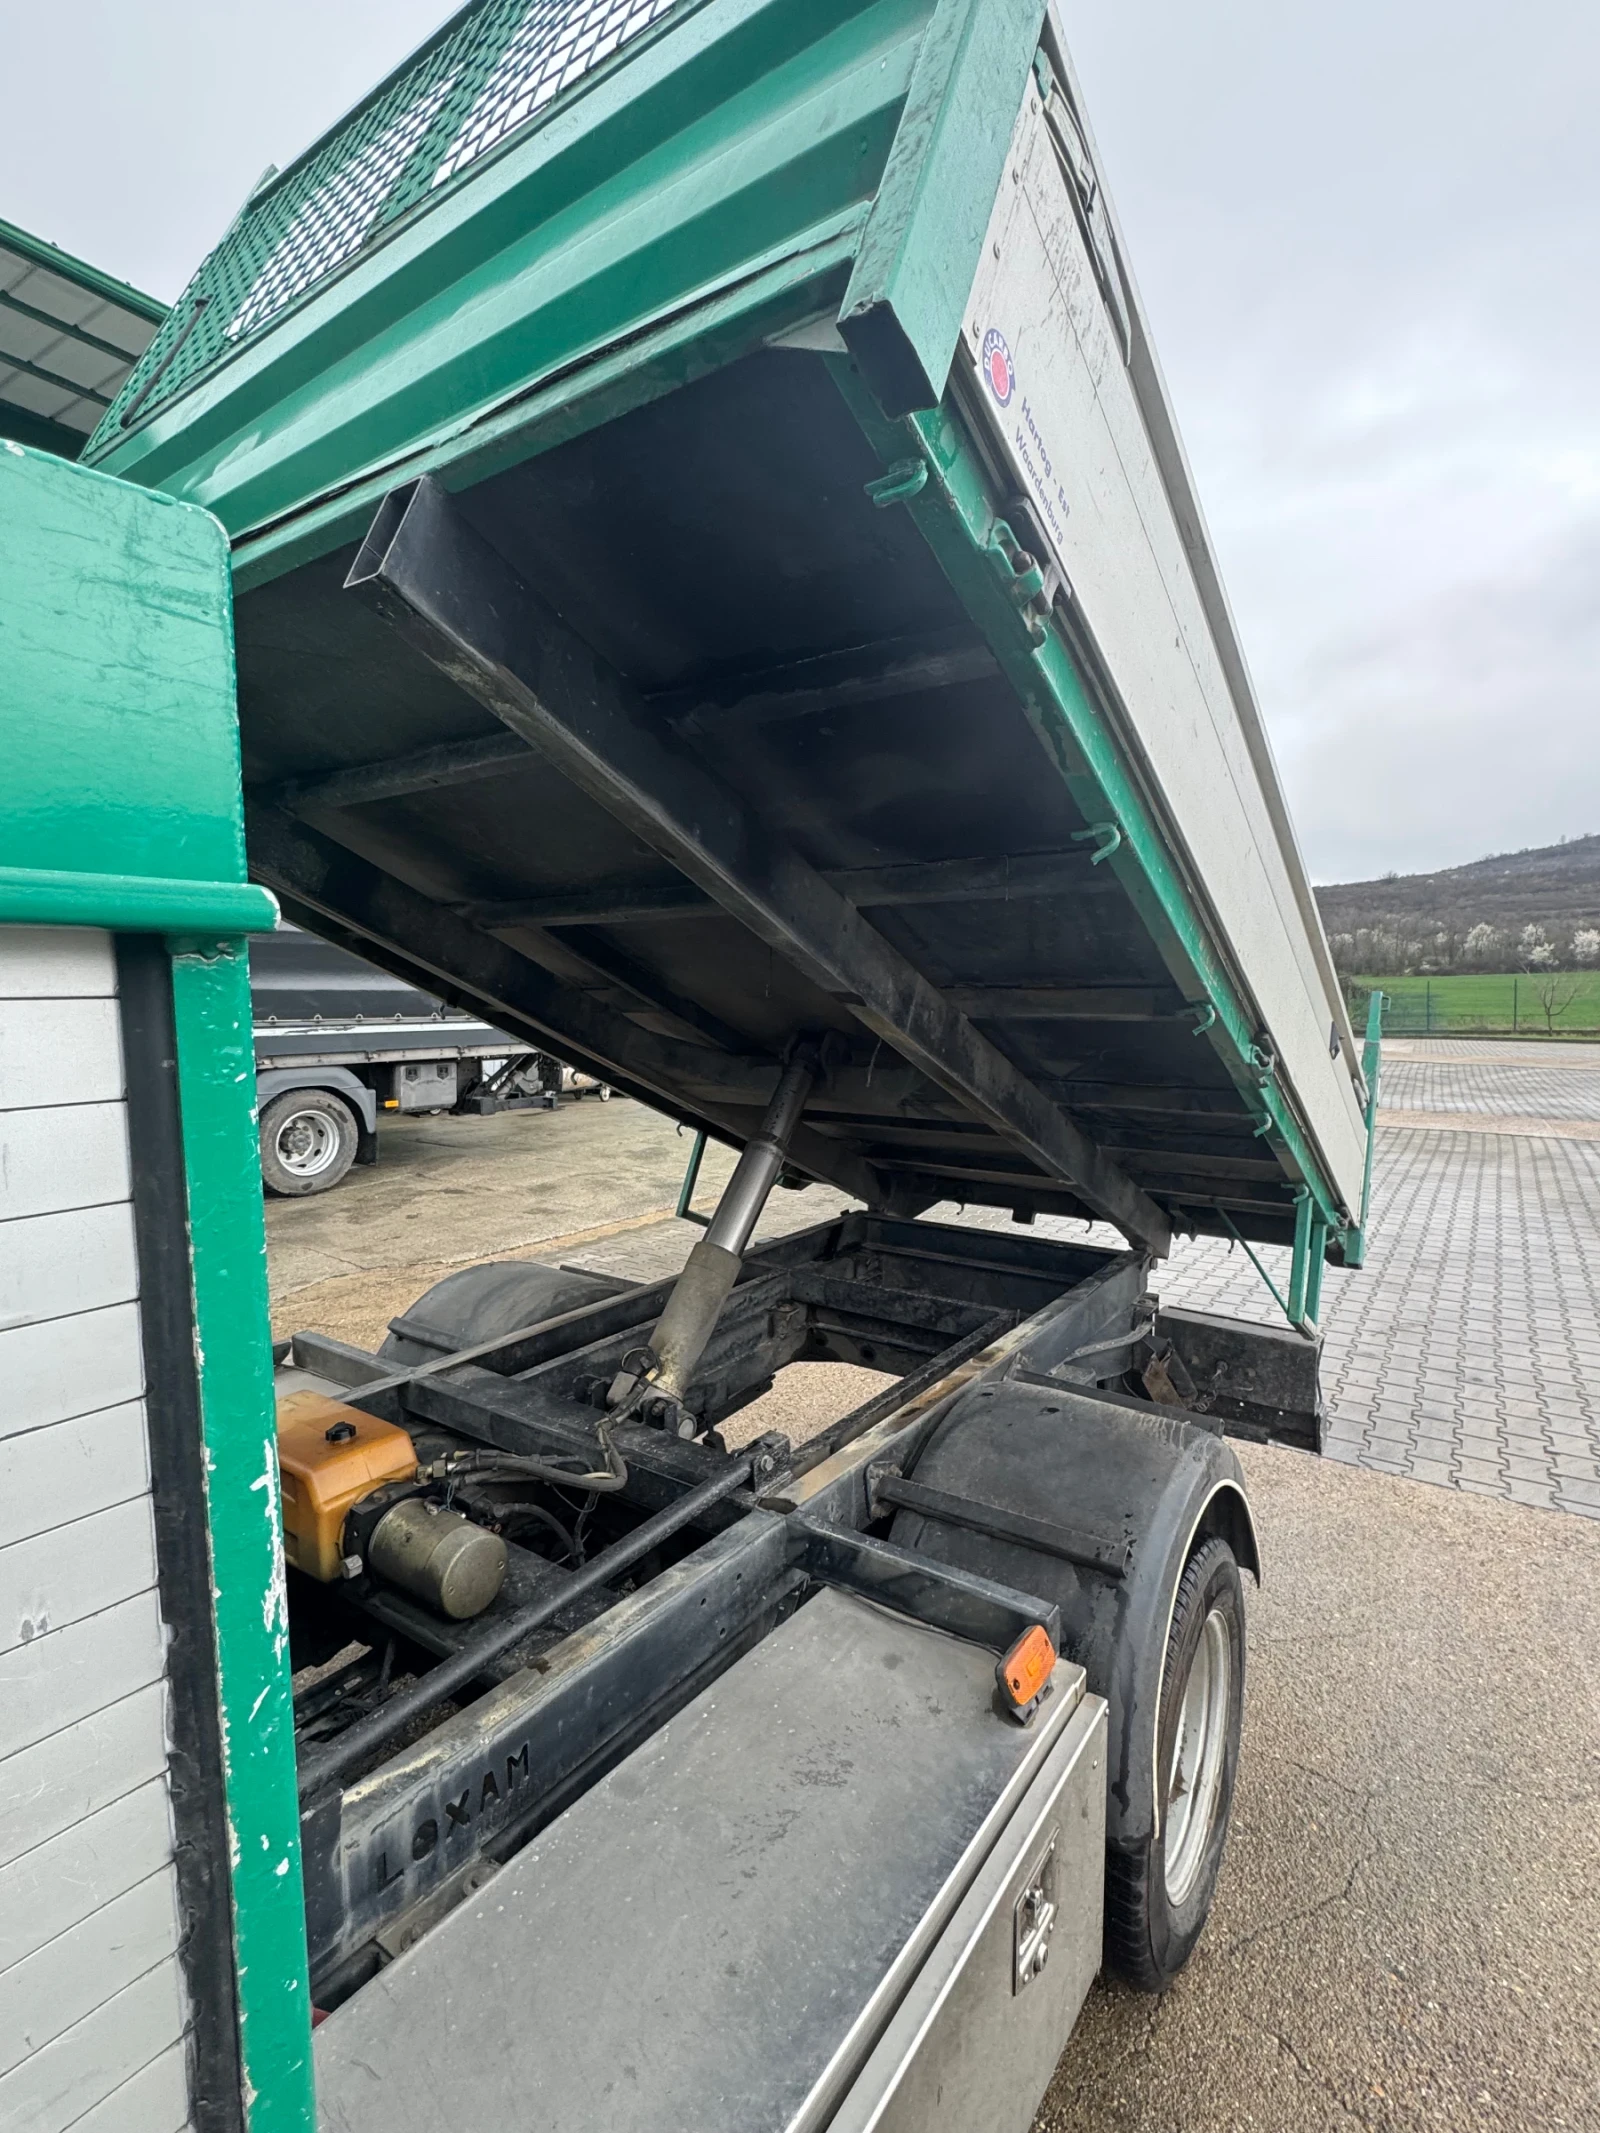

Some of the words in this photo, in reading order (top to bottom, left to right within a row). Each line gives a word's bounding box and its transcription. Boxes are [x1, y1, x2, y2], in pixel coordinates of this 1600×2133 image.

[1016, 425, 1064, 545] Waardenburg
[1022, 396, 1052, 478] Hartog
[377, 1743, 529, 1892] LOXAM
